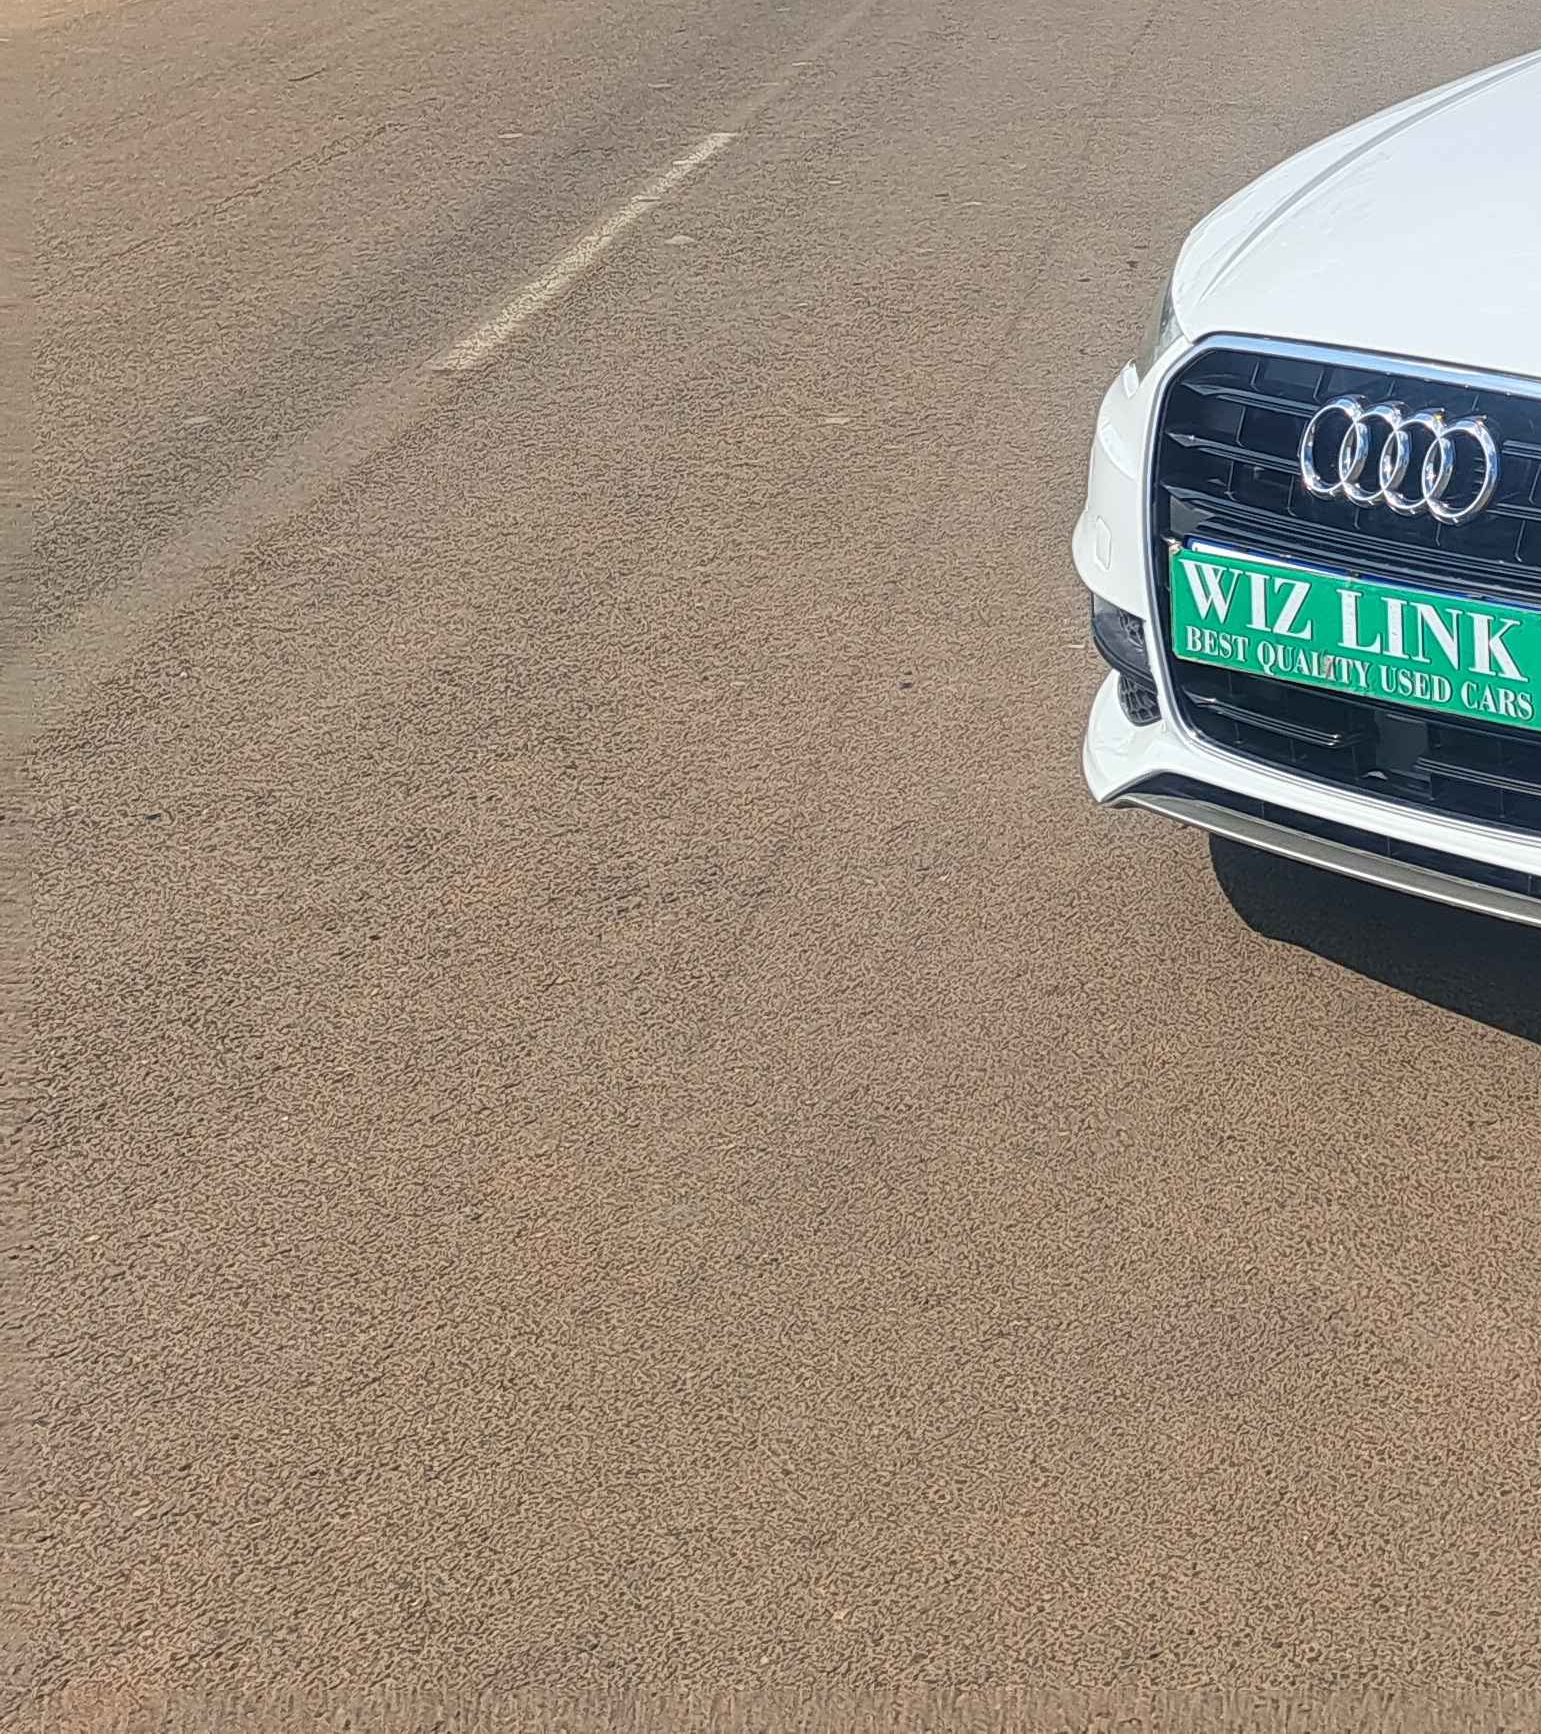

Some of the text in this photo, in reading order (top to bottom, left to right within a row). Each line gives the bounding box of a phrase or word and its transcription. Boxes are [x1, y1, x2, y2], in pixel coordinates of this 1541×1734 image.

[1178, 557, 1529, 683] WIZ LINK
[1185, 624, 1535, 722] BEST QUALITY USED CARS
